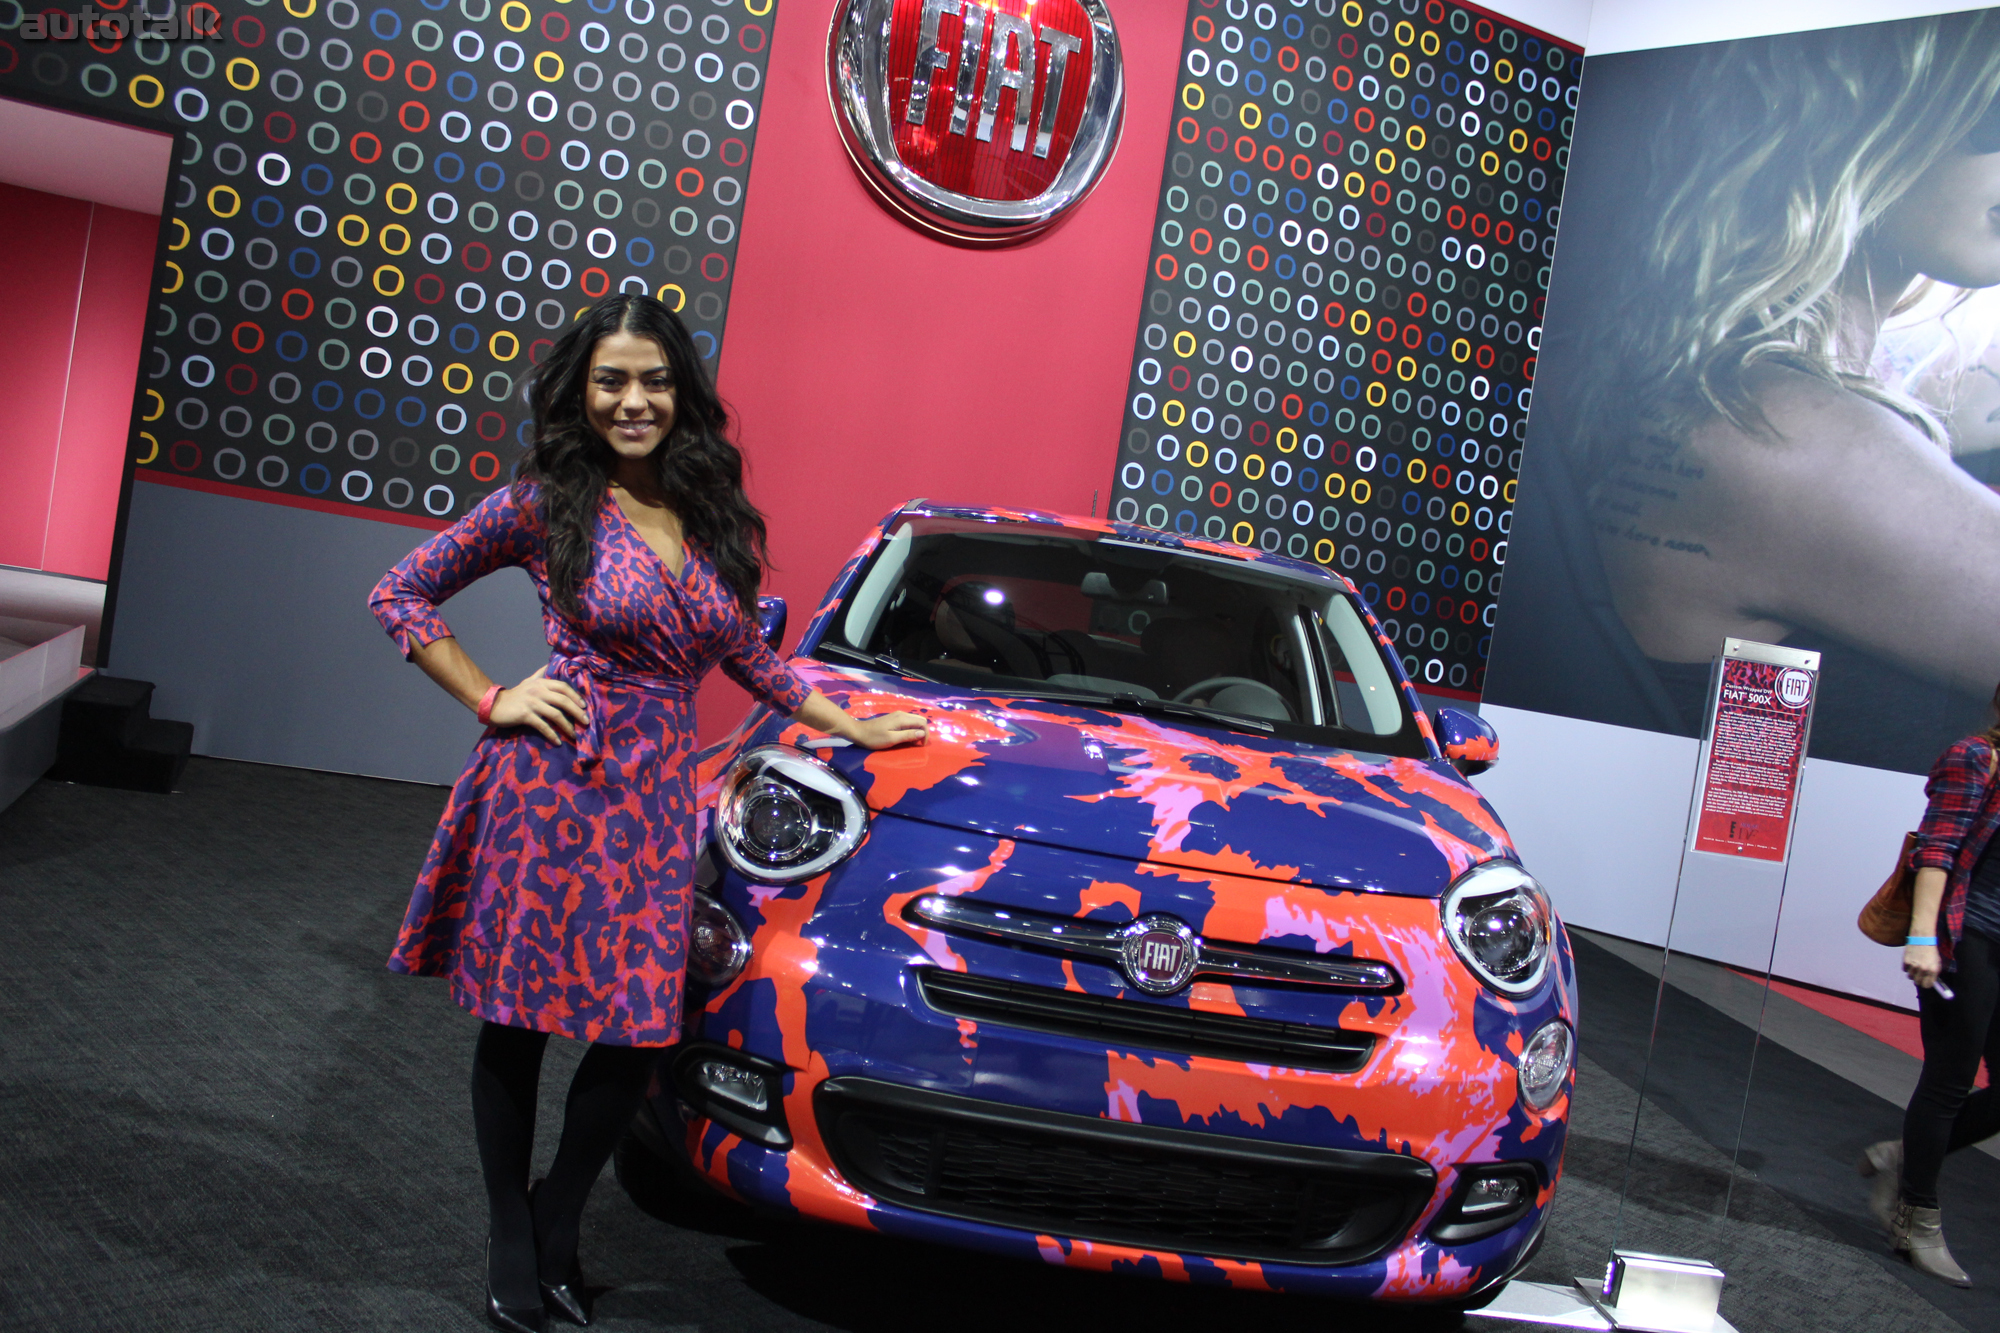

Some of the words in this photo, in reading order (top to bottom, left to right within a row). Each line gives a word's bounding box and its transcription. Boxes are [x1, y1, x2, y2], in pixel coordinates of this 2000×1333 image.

[905, 0, 1082, 159] FIAT
[1748, 692, 1772, 706] 500X
[1785, 678, 1808, 697] FIAT
[1143, 941, 1181, 973] FIAT
